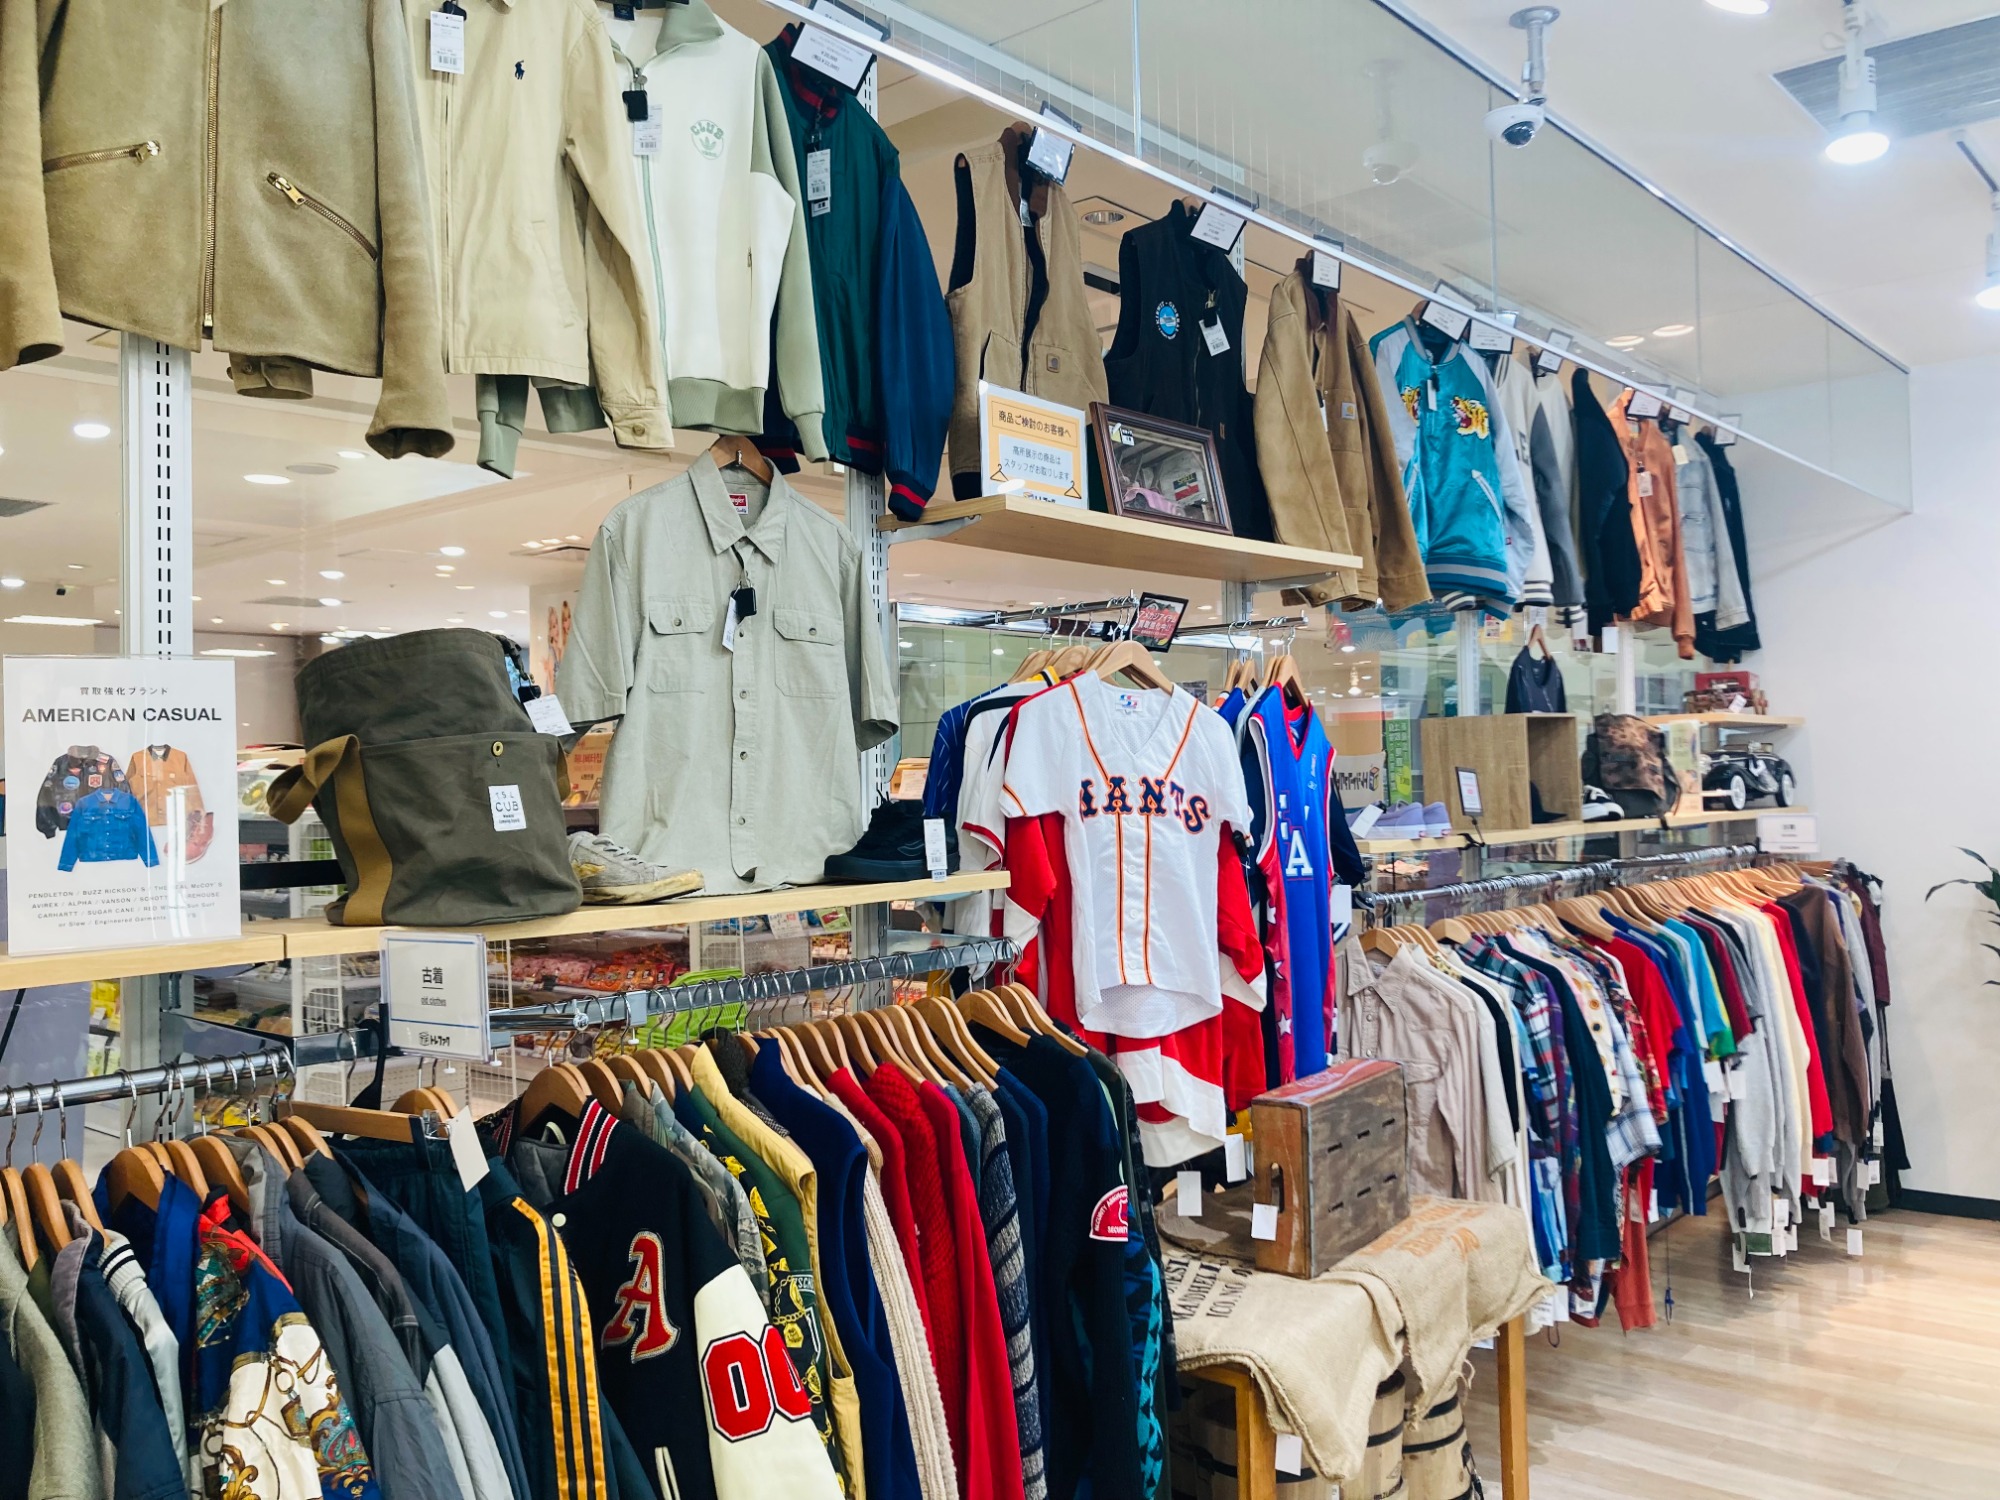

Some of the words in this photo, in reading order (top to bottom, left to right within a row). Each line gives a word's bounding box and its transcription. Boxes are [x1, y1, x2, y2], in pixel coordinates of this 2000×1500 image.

[690, 121, 724, 140] CLUB
[998, 410, 1072, 438] 商品ご検討のお客様へ
[1004, 458, 1070, 480] スタッフがお取りします
[80, 686, 168, 696] 買取強化ブランド
[22, 707, 135, 723] AMERICAN
[143, 707, 222, 722] CASUAL
[495, 801, 519, 812] CUB
[1079, 775, 1212, 835] IANTS
[28, 891, 74, 899] PENDLETON
[31, 901, 59, 909] AVIREX
[101, 897, 131, 905] VANSON
[37, 911, 78, 919] CARHARTT
[94, 917, 133, 926] Engineered
[134, 915, 167, 923] Garments
[422, 967, 443, 984] 古着
[601, 1229, 682, 1365] A
